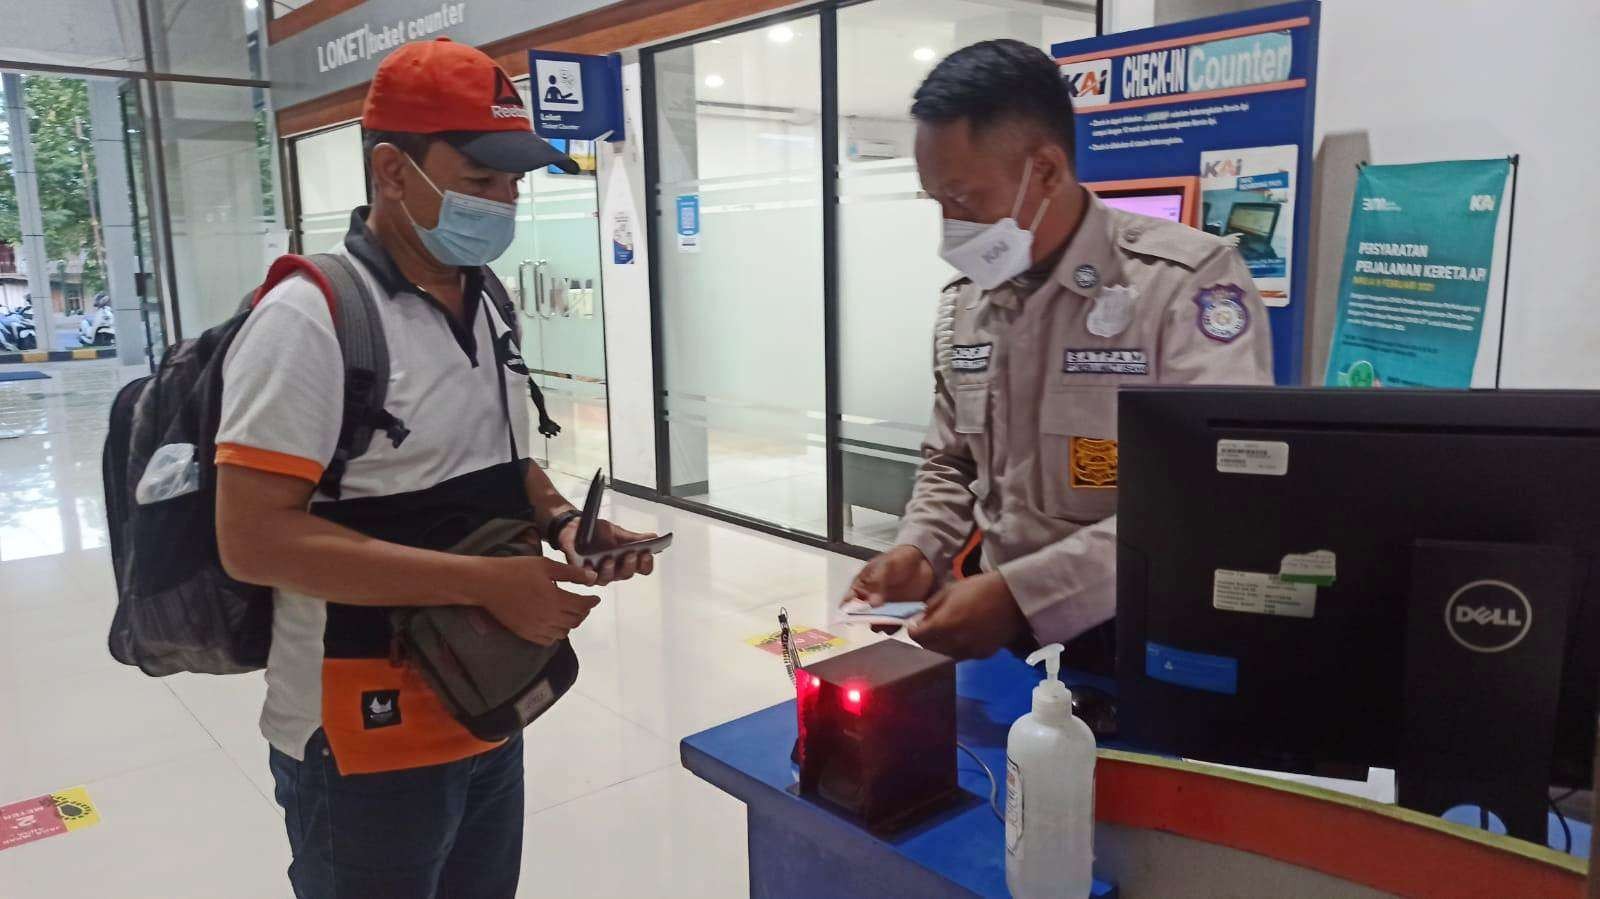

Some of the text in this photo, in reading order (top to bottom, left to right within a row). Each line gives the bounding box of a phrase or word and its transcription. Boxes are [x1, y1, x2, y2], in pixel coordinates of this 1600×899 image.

[317, 29, 365, 72] LOKET
[1122, 47, 1187, 99] CHECK-IN
[1188, 42, 1291, 90] Counter
[1455, 605, 1522, 627] DELL
